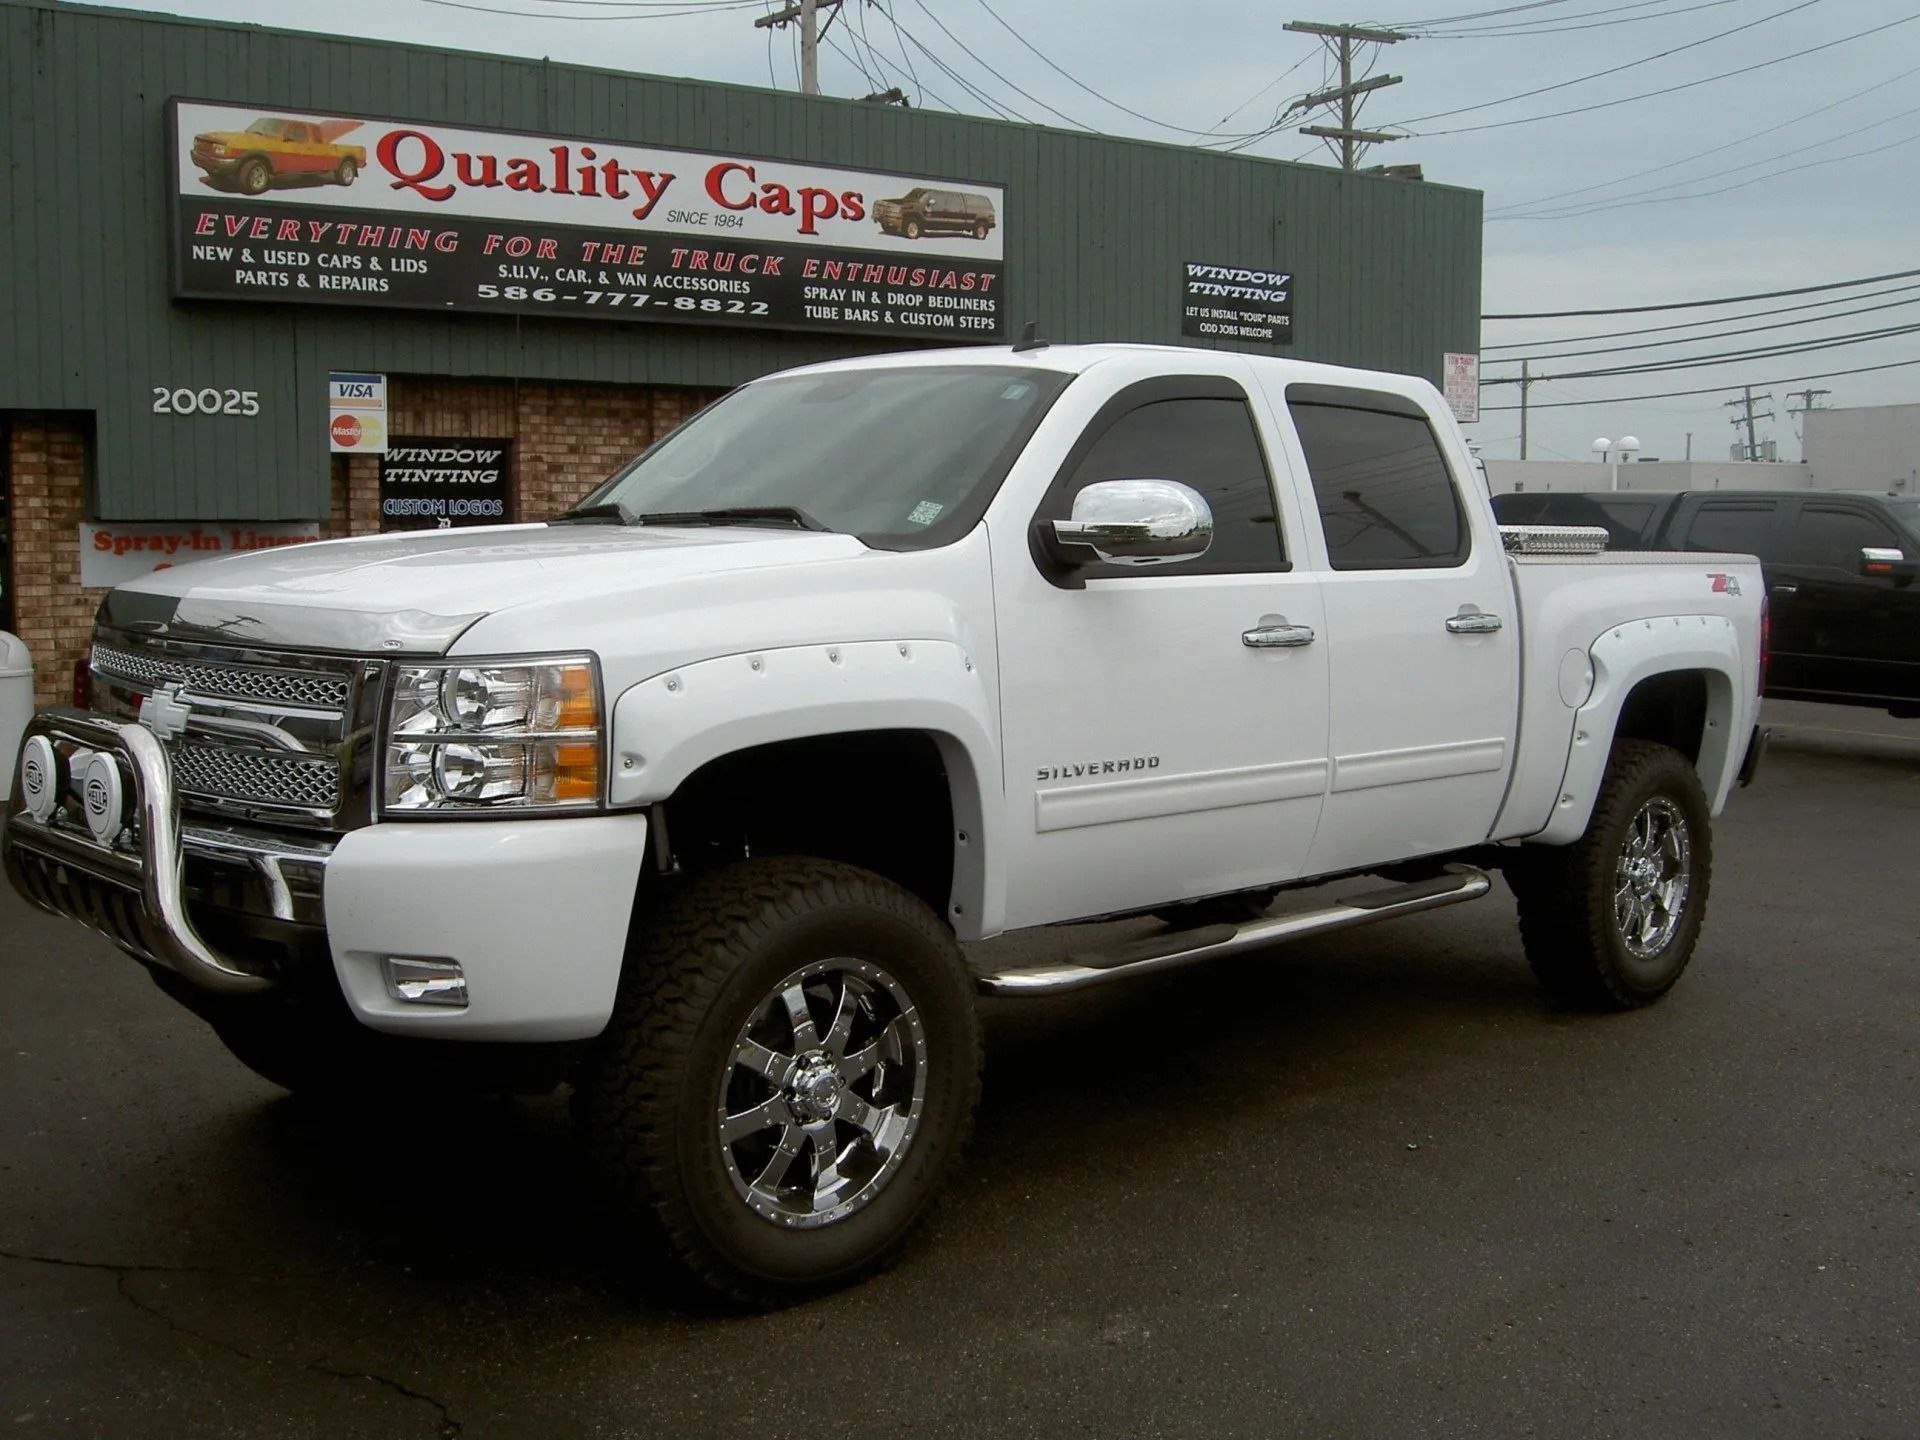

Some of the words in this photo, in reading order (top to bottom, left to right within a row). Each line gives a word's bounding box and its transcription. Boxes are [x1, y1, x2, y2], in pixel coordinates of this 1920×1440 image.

[376, 129, 676, 220] Quality
[704, 162, 866, 235] Caps
[667, 210, 708, 226] SINCE
[713, 214, 744, 228] 1984
[192, 245, 233, 261] NEW
[241, 248, 256, 263] &
[263, 249, 310, 266] USED
[317, 253, 362, 269] CAPS
[369, 256, 383, 271] &
[391, 257, 428, 274] LIDS
[195, 213, 459, 252] EVERYTHING
[483, 234, 558, 259] FOR
[582, 241, 648, 266] THE
[671, 248, 784, 276] TRUCK
[802, 259, 996, 292] ENTHUSIAST
[235, 269, 289, 287] PARTS
[296, 273, 311, 288] &
[319, 274, 389, 292] REPAIRS
[555, 267, 591, 284] CAR,
[597, 271, 610, 285] &
[616, 272, 647, 287] VAN
[653, 274, 751, 294] ACCESSORIES
[1187, 264, 1290, 286] WINDOW
[477, 284, 770, 316] 586-777-8822
[804, 285, 847, 301] SPRAY
[851, 290, 866, 303] IN
[871, 291, 881, 304] &
[887, 292, 923, 307] DROP
[928, 296, 996, 312] BEDLINERS
[1188, 282, 1287, 302] TINTING
[804, 305, 839, 320] TUBE
[844, 308, 879, 323] BARS
[884, 311, 895, 324] &
[900, 312, 954, 327] CUSTOM
[959, 316, 995, 330] STEPS
[1186, 306, 1198, 317] LET
[1200, 307, 1210, 318] US
[1211, 309, 1238, 321] INSTALL
[1267, 314, 1290, 326] PARTS
[1200, 322, 1218, 334] ODD
[1219, 324, 1239, 336] JOBS
[1240, 326, 1273, 339] WELCOME
[152, 387, 260, 417] 20025
[339, 384, 373, 398] VISA
[384, 448, 502, 463] WINDOW
[385, 469, 499, 484] TINTING
[383, 498, 446, 516] CUSTOM
[448, 499, 503, 516] LOGOS
[93, 529, 222, 555] Spray-In
[1037, 756, 1160, 781] SILVERADO
